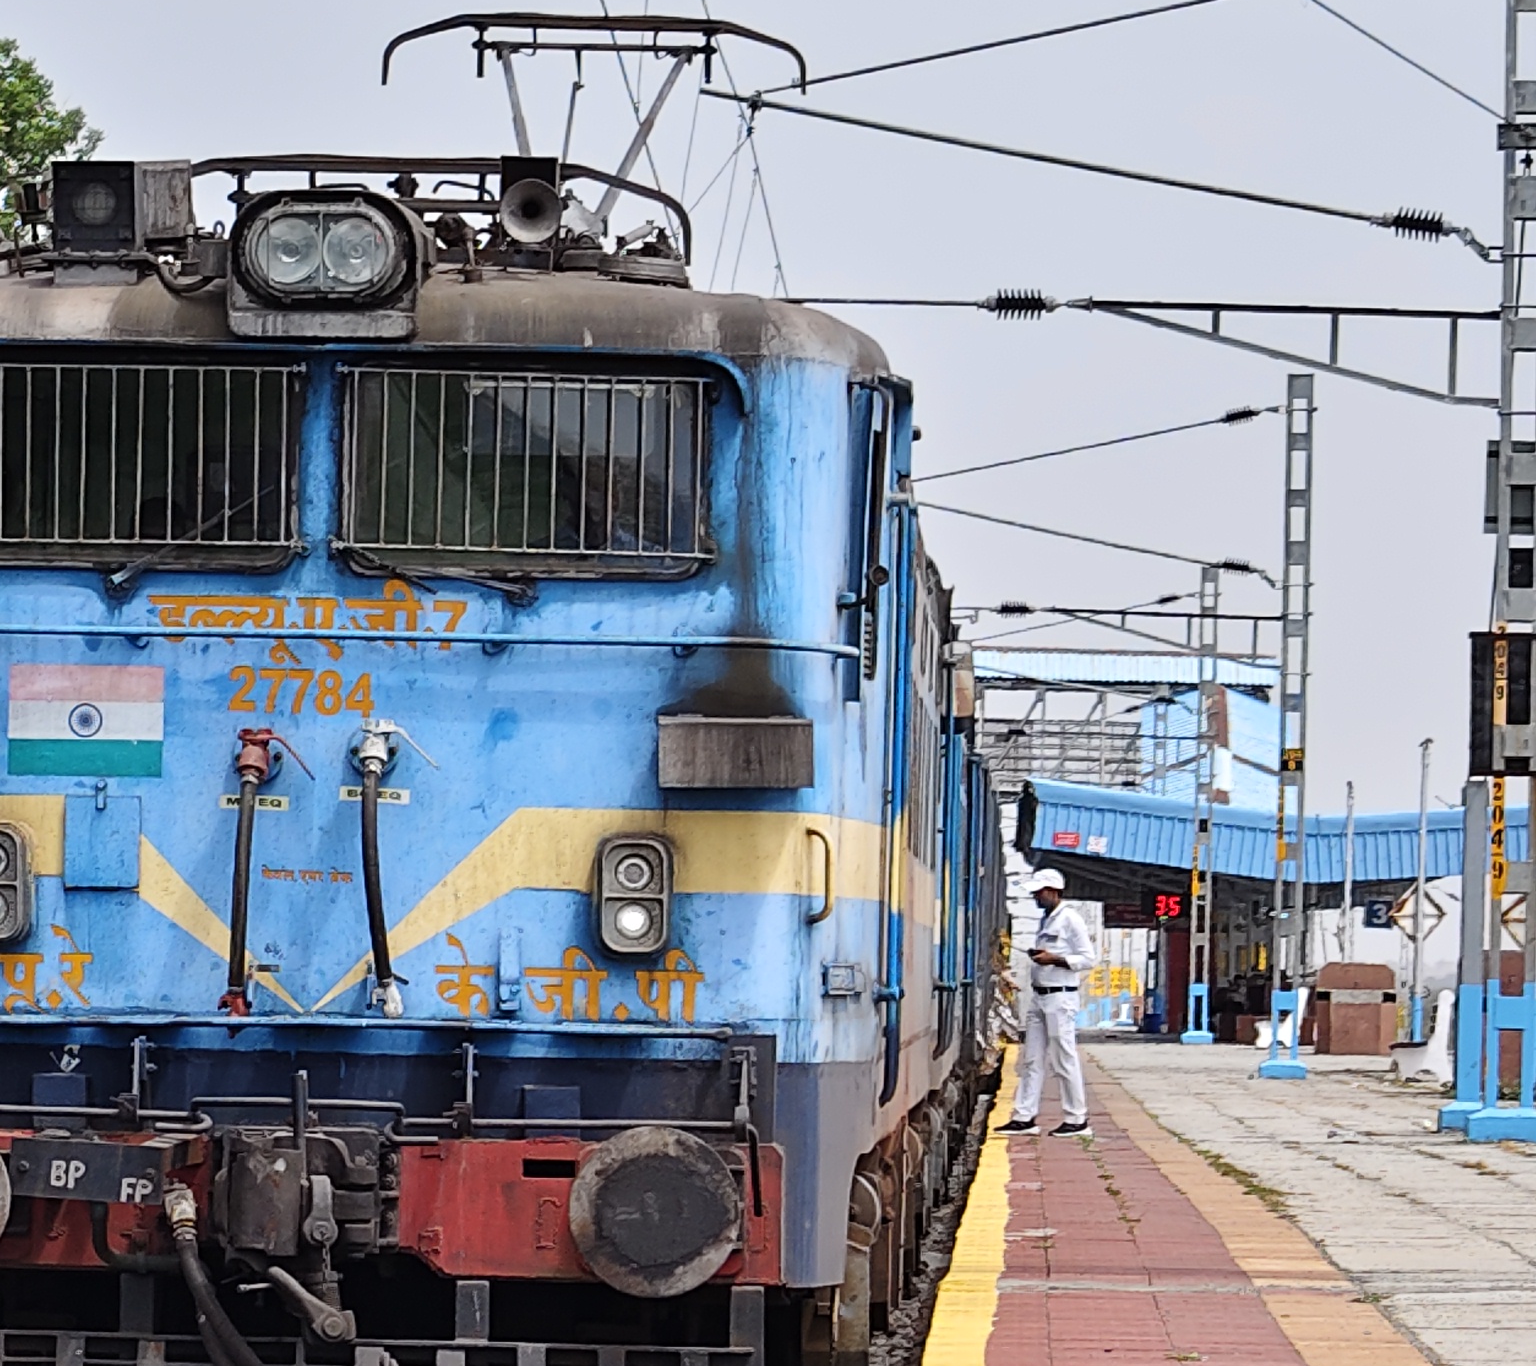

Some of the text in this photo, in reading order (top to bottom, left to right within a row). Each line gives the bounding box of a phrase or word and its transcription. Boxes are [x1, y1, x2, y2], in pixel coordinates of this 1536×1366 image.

[228, 666, 375, 718] 27784
[1371, 903, 1388, 924] 3
[50, 1160, 86, 1189] BP
[119, 1177, 154, 1203] FP
